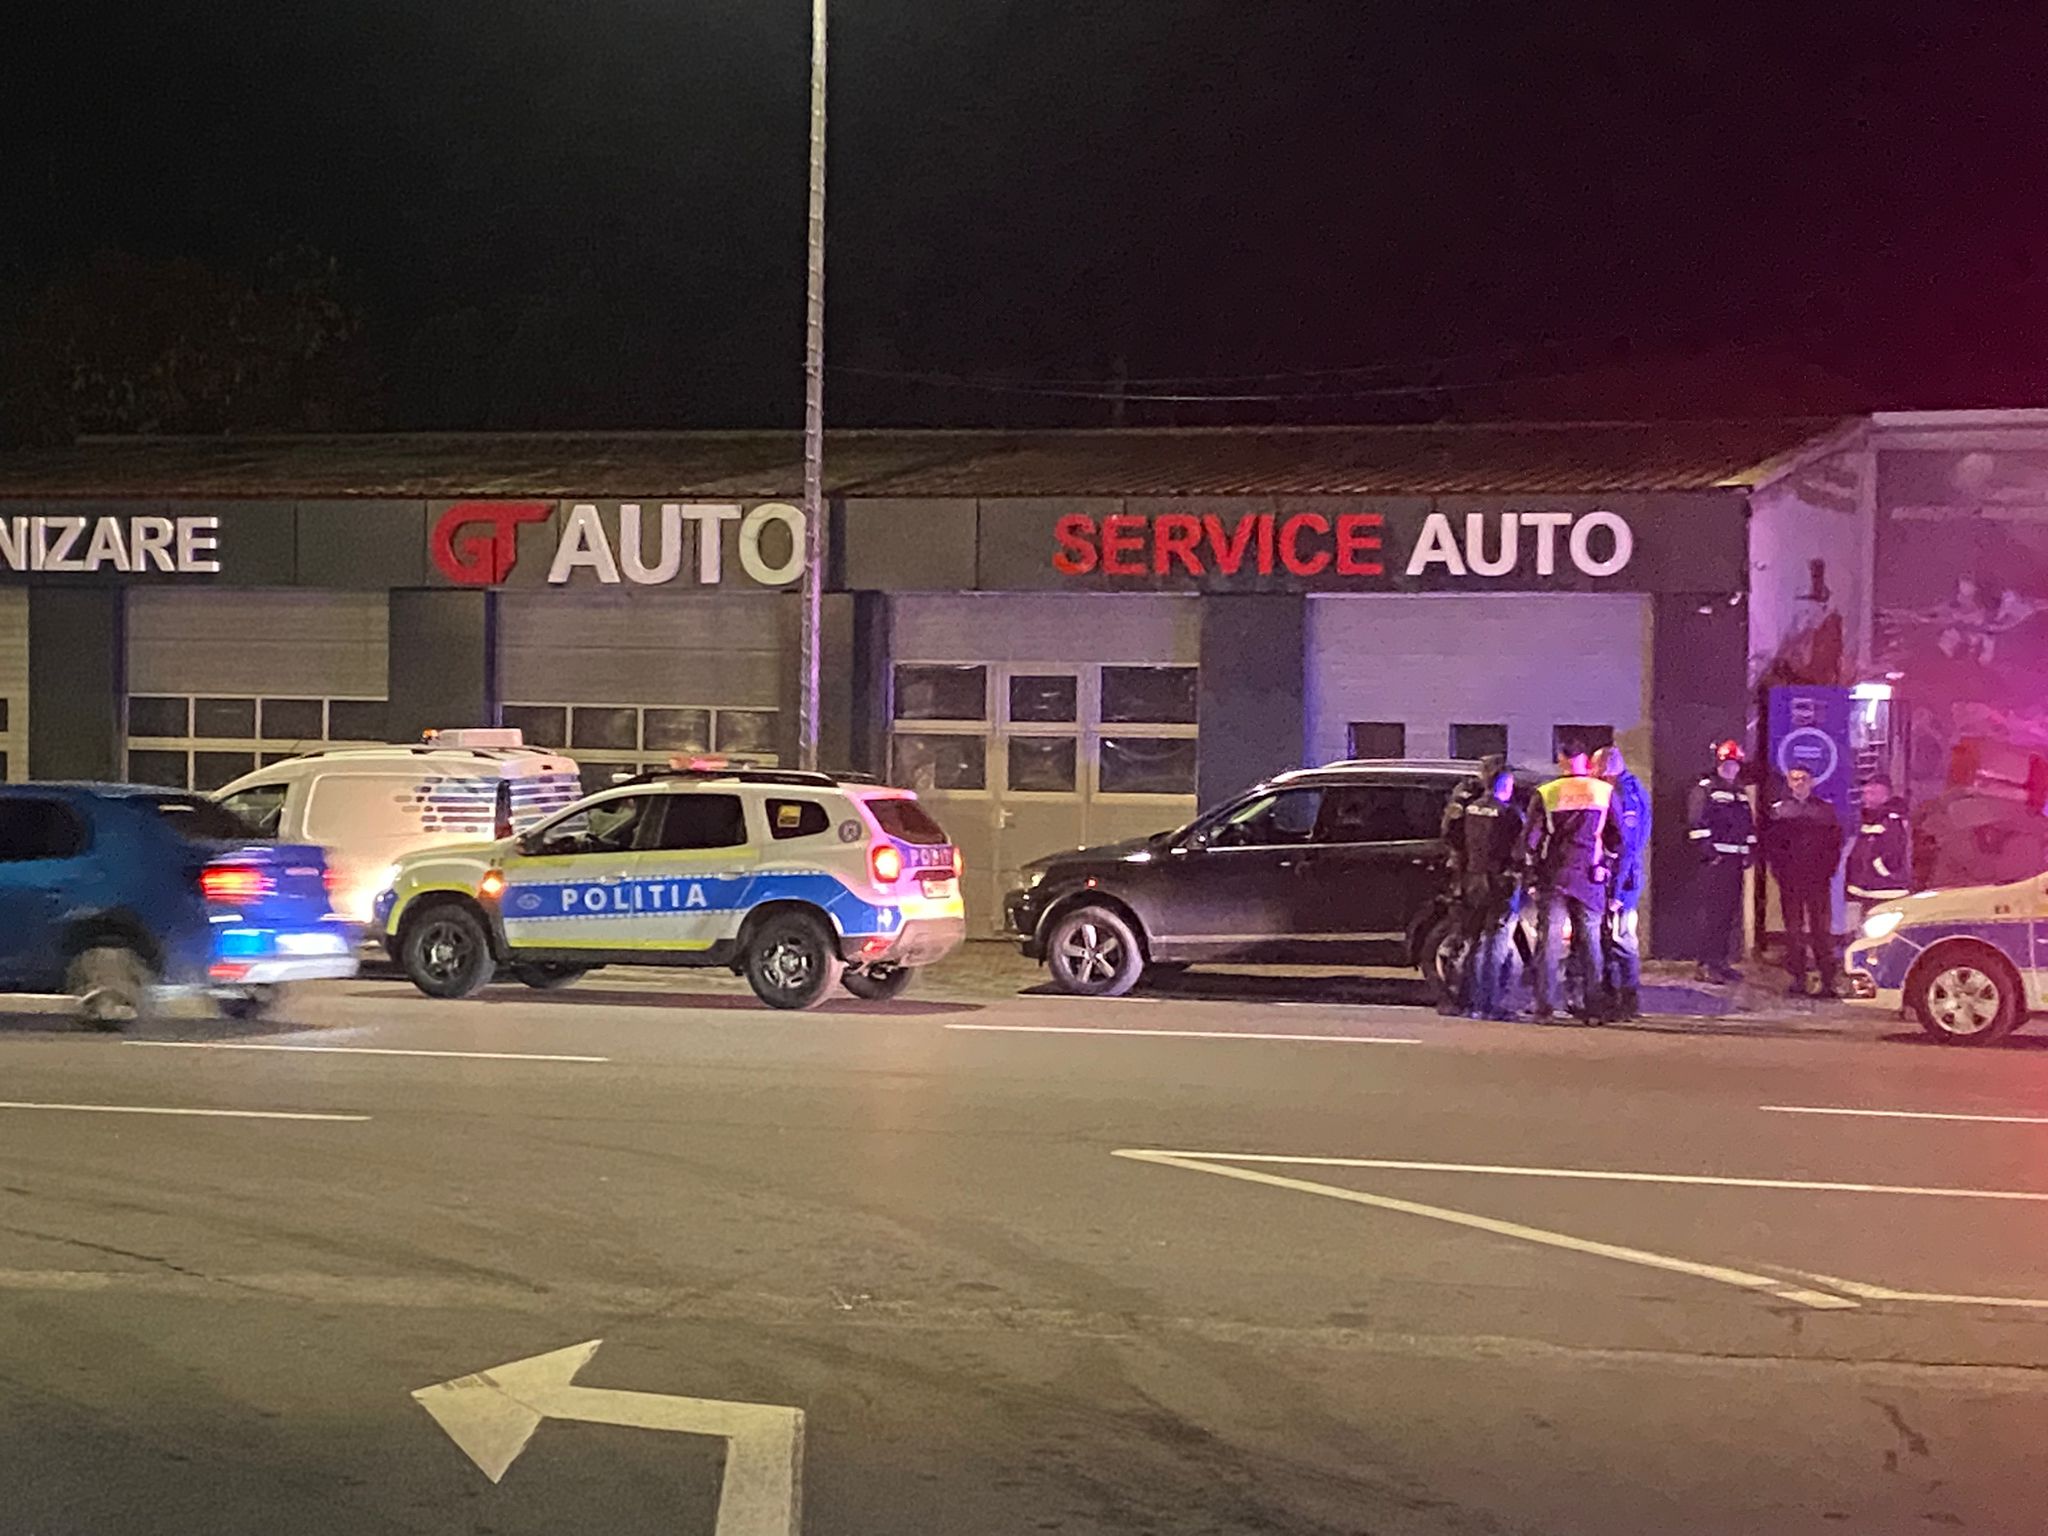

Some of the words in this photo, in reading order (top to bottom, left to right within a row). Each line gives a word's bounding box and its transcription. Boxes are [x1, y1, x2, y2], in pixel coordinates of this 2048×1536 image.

[432, 500, 552, 585] GT
[547, 502, 807, 585] AUTO
[1053, 513, 1384, 576] SERVICE
[1406, 511, 1633, 577] AUTO
